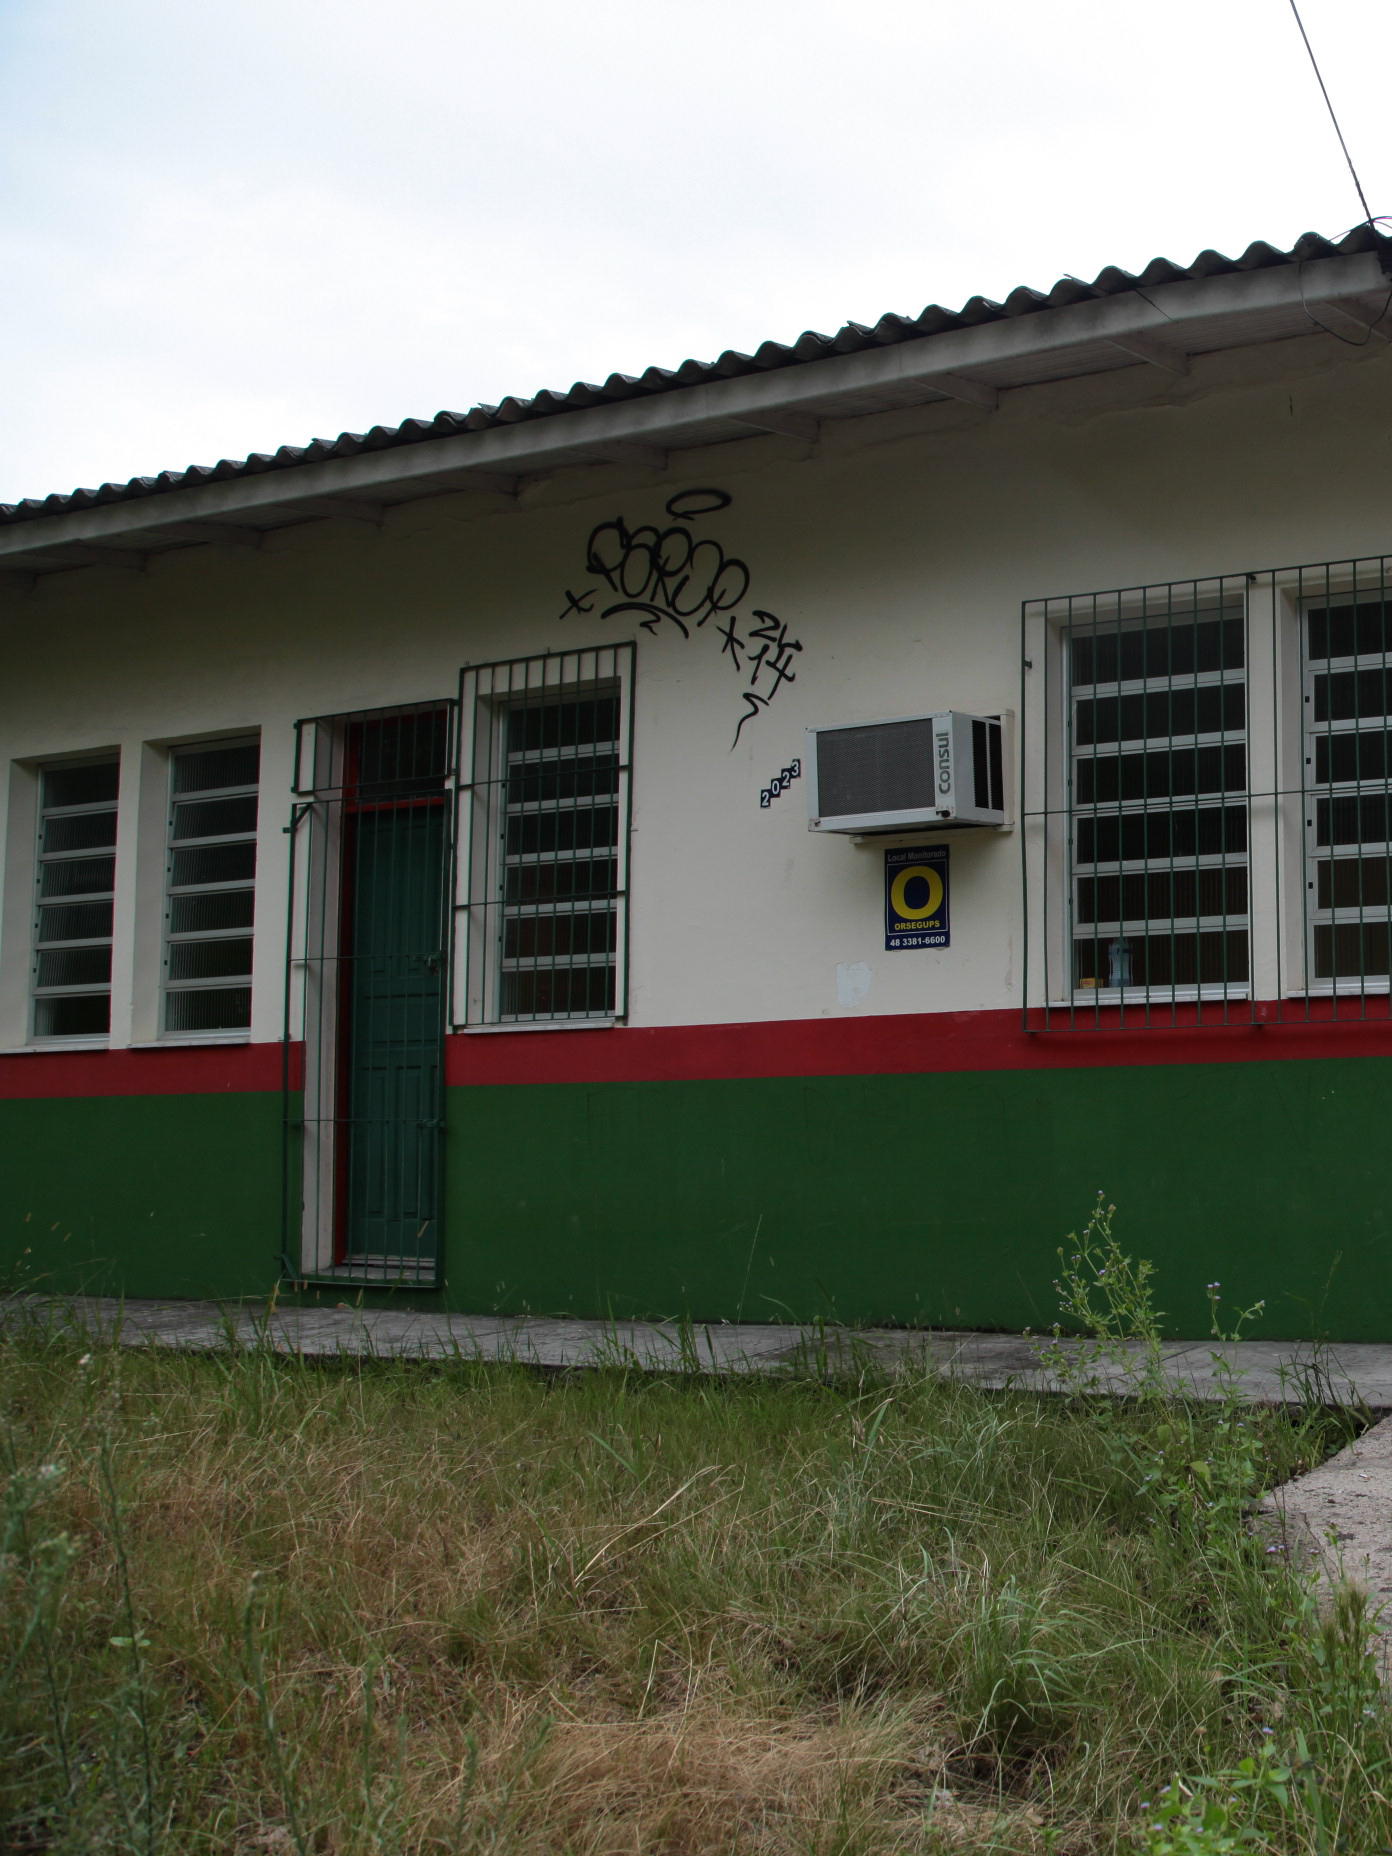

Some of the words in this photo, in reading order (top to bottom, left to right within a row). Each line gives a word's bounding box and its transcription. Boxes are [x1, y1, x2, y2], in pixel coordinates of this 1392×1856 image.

[760, 760, 801, 808] 2023
[887, 853, 907, 862] Local
[907, 849, 946, 860] Monitorado
[894, 920, 940, 931] ORSEGUPS
[889, 938, 901, 947] 48
[902, 935, 946, 946] 3381-6600
